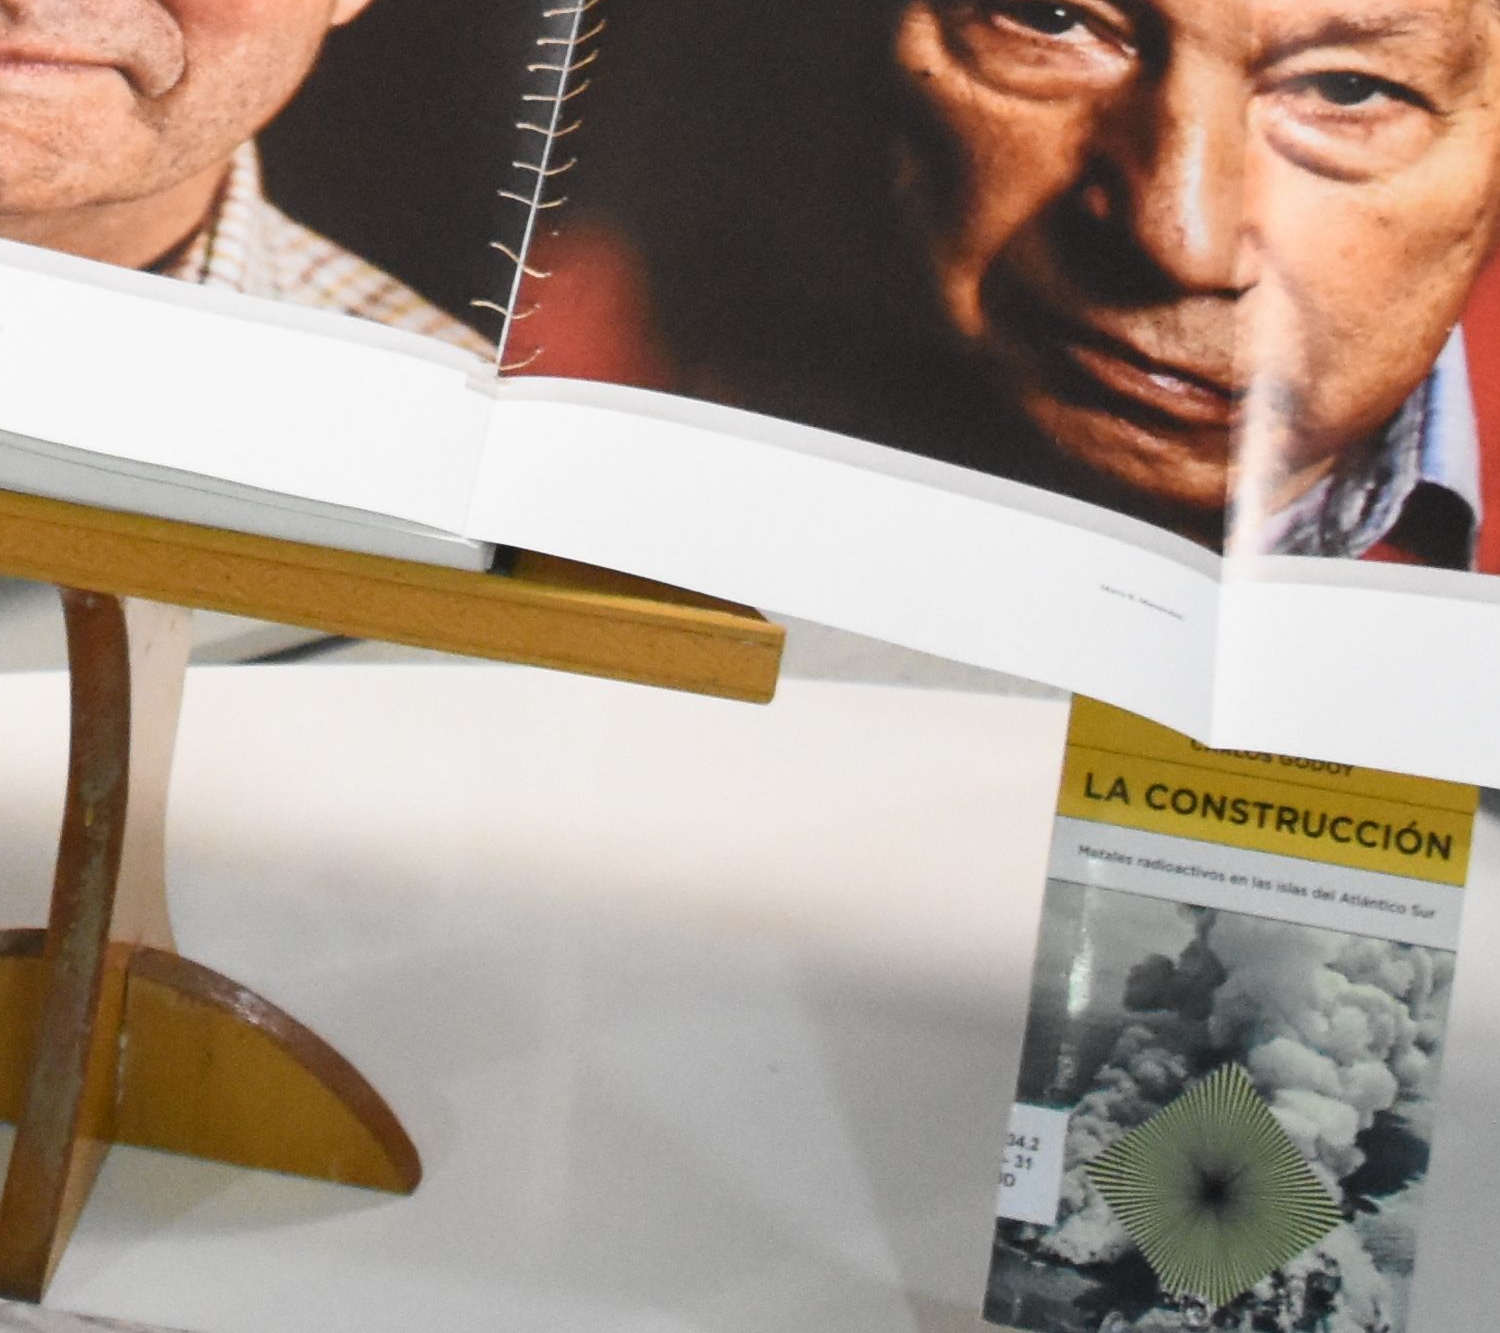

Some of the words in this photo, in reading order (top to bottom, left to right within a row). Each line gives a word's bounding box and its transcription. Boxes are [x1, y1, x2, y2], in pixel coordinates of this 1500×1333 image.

[1191, 738, 1273, 764] COS
[1084, 771, 1132, 807] LA
[1144, 781, 1454, 863] CONSTRUCCIÓN
[1078, 844, 1133, 866] Metales
[1137, 857, 1226, 883] radioactivos
[1229, 874, 1249, 886] en
[1252, 876, 1272, 891] las
[1276, 882, 1308, 898] islas
[1312, 887, 1336, 902] del
[1340, 891, 1407, 916] Atlántico
[1411, 904, 1436, 920] Sur
